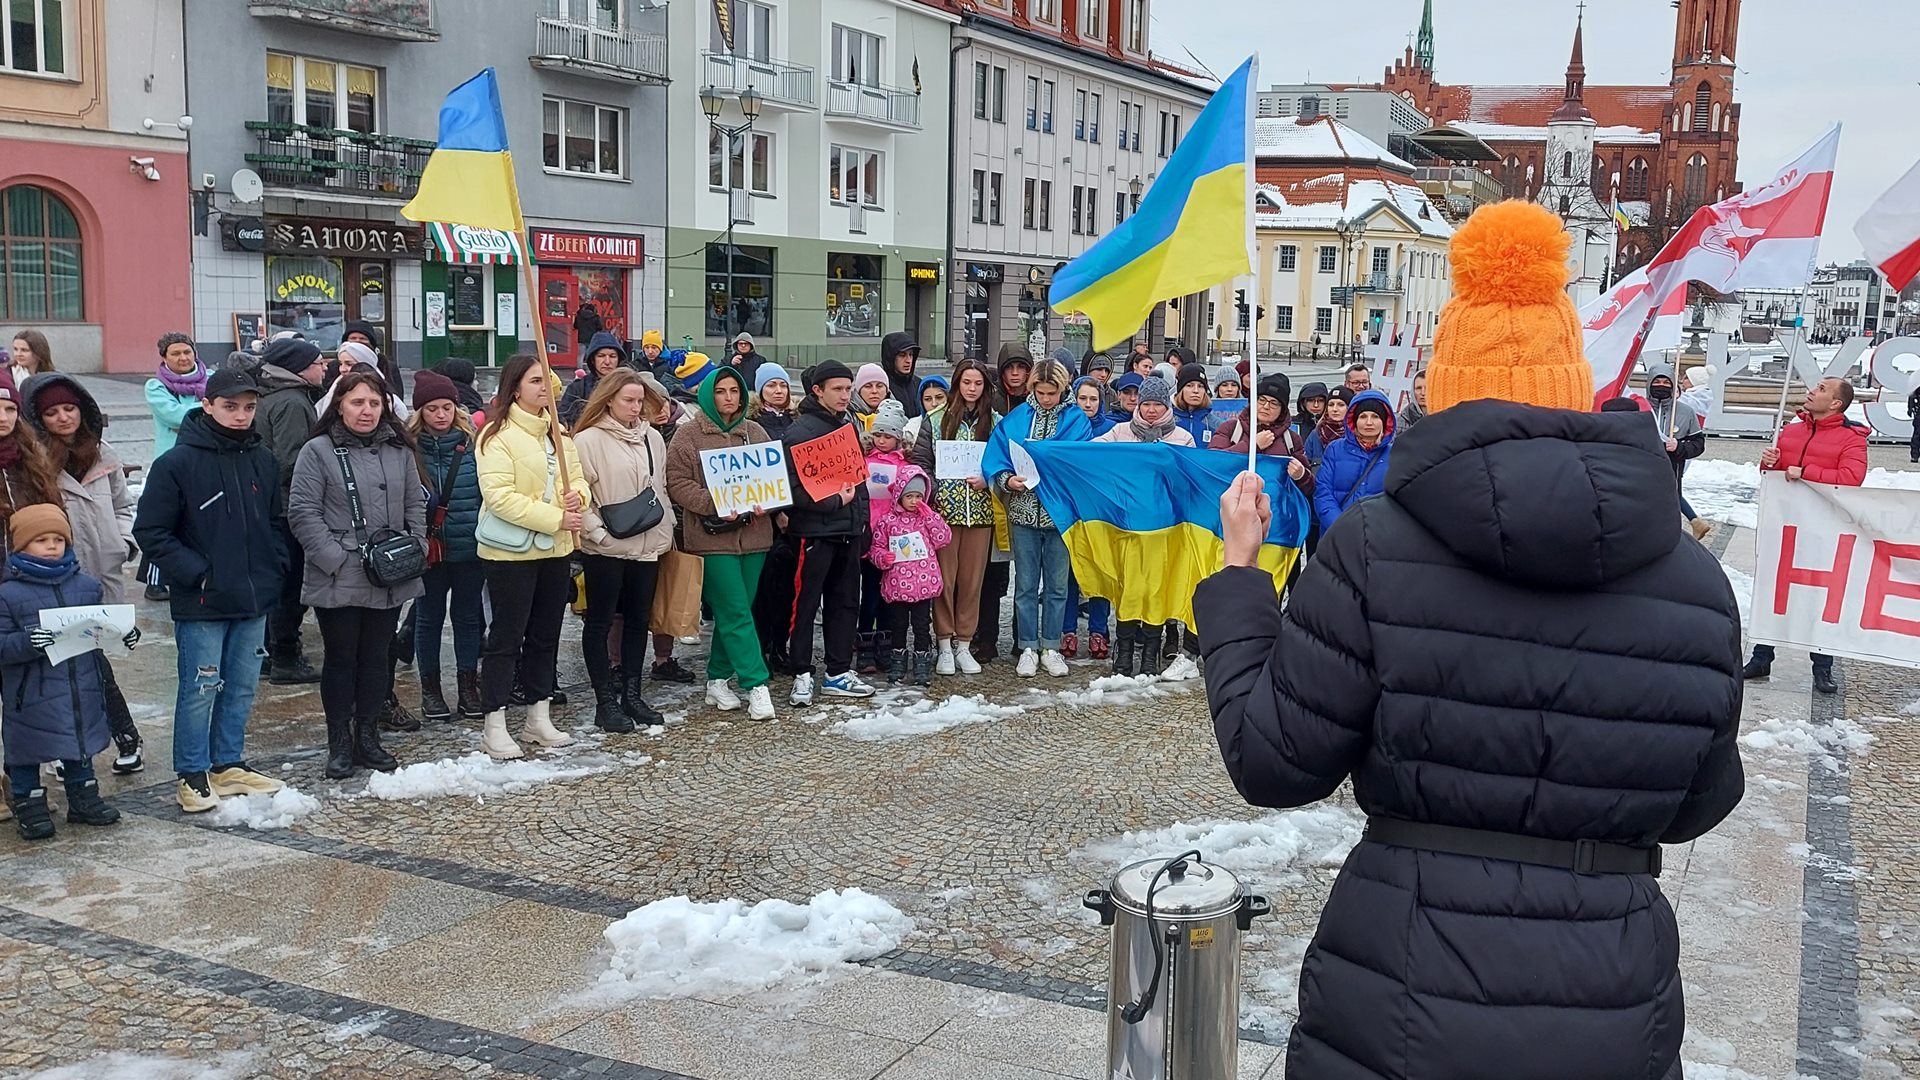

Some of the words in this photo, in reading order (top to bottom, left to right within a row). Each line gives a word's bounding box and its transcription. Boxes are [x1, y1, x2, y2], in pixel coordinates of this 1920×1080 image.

[910, 268, 936, 279] SPHINX
[277, 274, 336, 299] SAVONA
[709, 447, 781, 474] STAND
